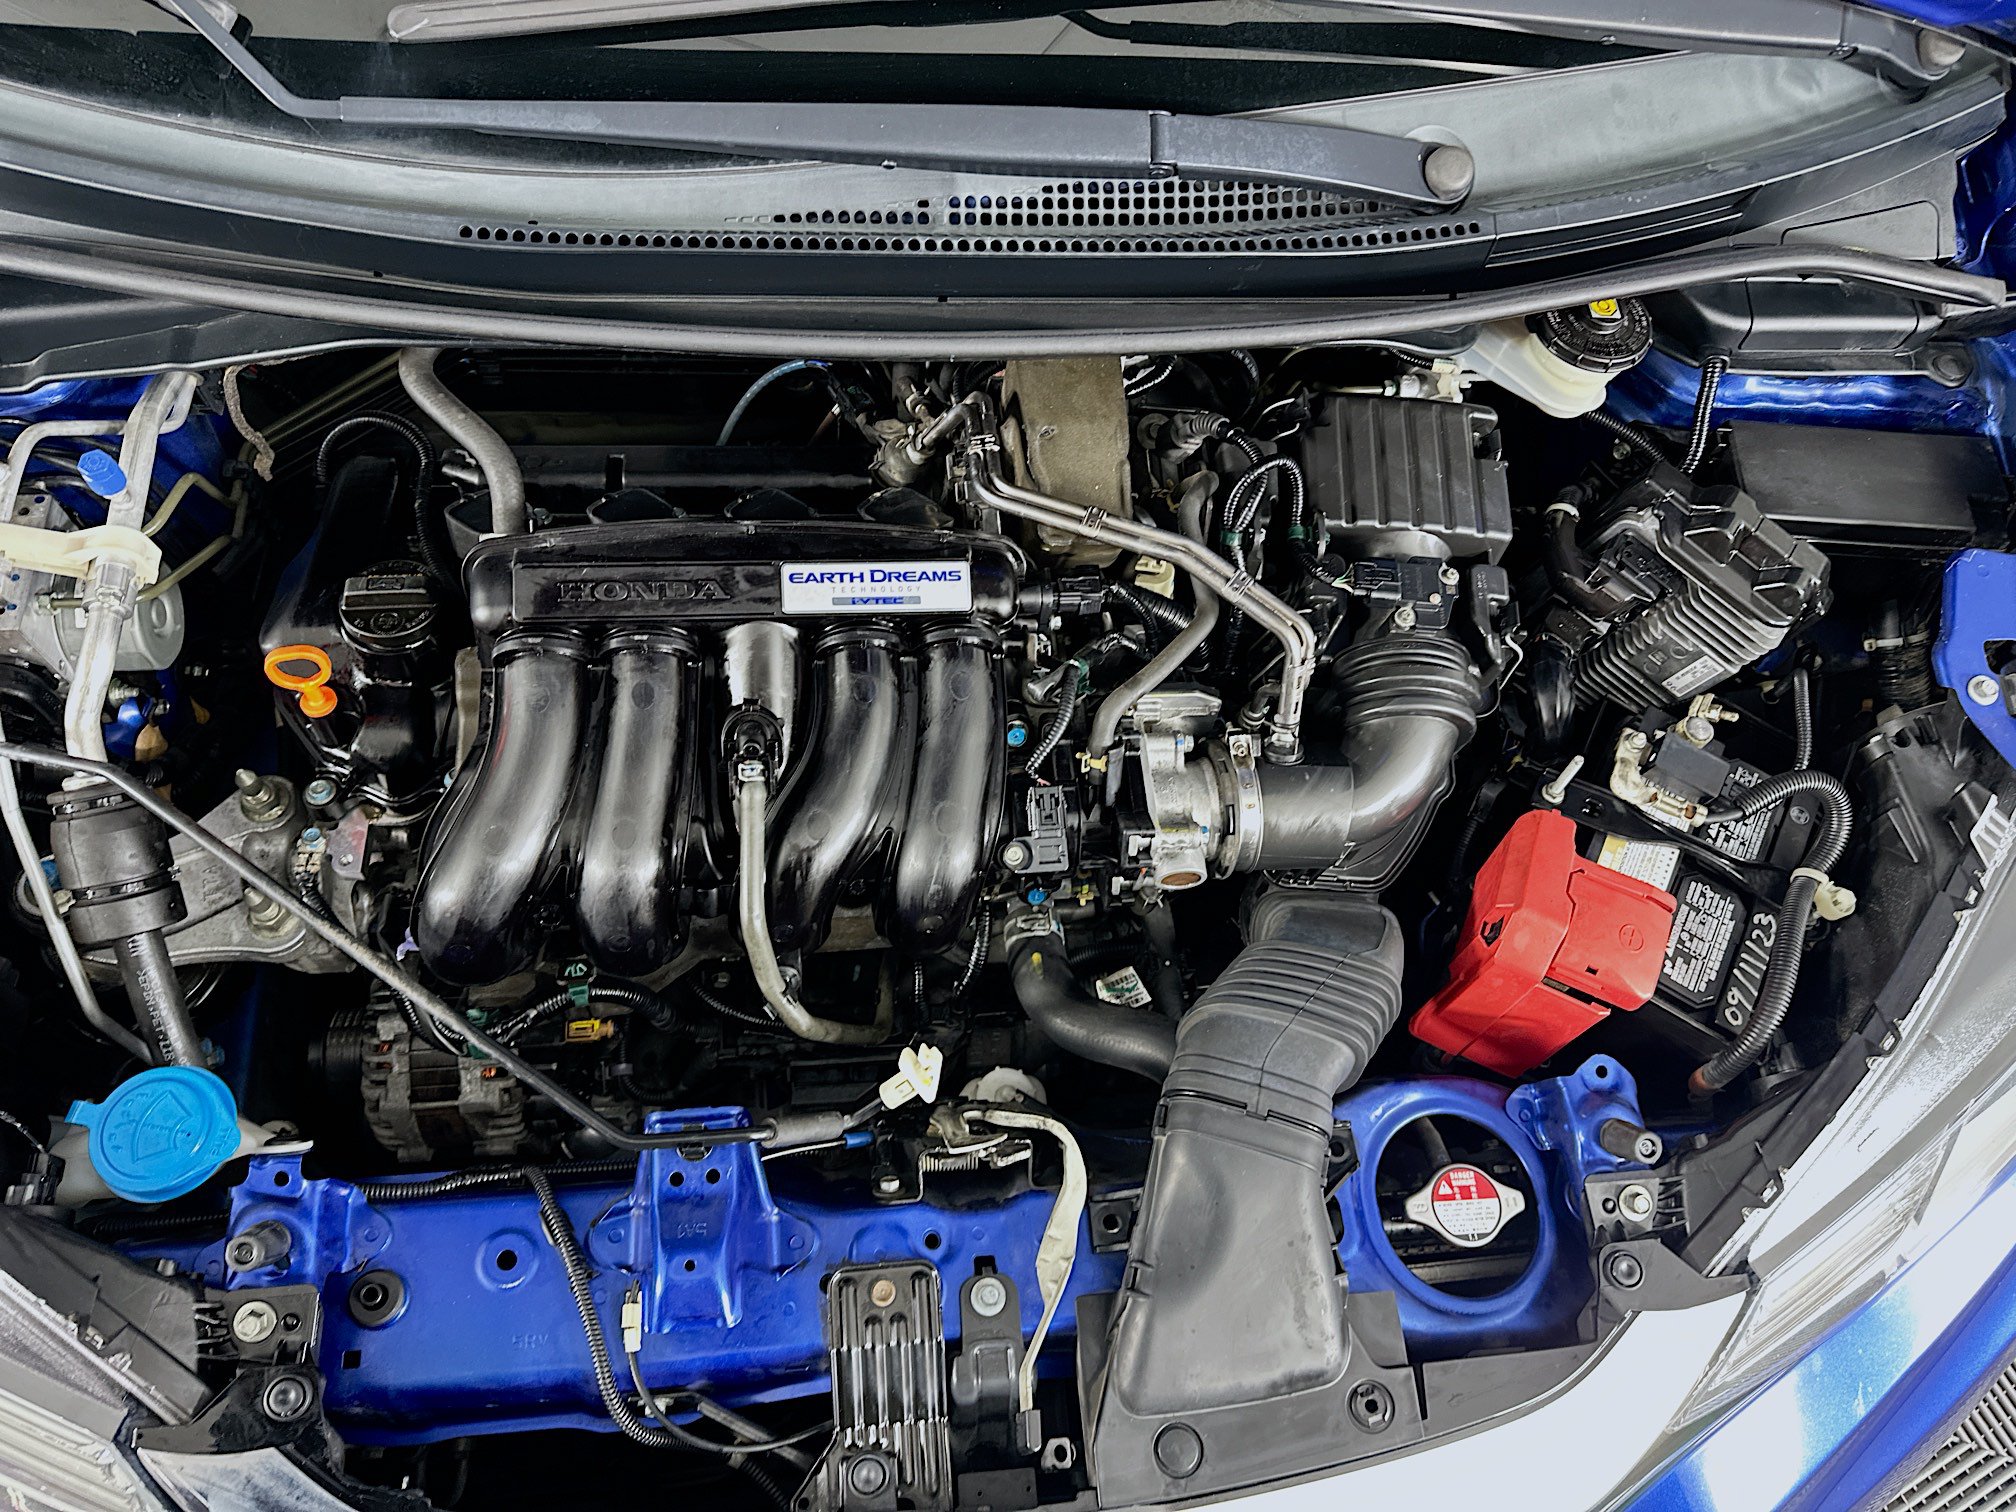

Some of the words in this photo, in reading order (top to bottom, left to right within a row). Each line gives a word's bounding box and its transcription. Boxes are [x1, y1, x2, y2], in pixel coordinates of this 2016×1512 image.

[788, 571, 864, 584] EARTH
[870, 569, 962, 583] DREAMS
[557, 579, 731, 602] HONDA
[1724, 913, 1777, 1026] 09/11/23
[1449, 1171, 1475, 1180] DANGER
